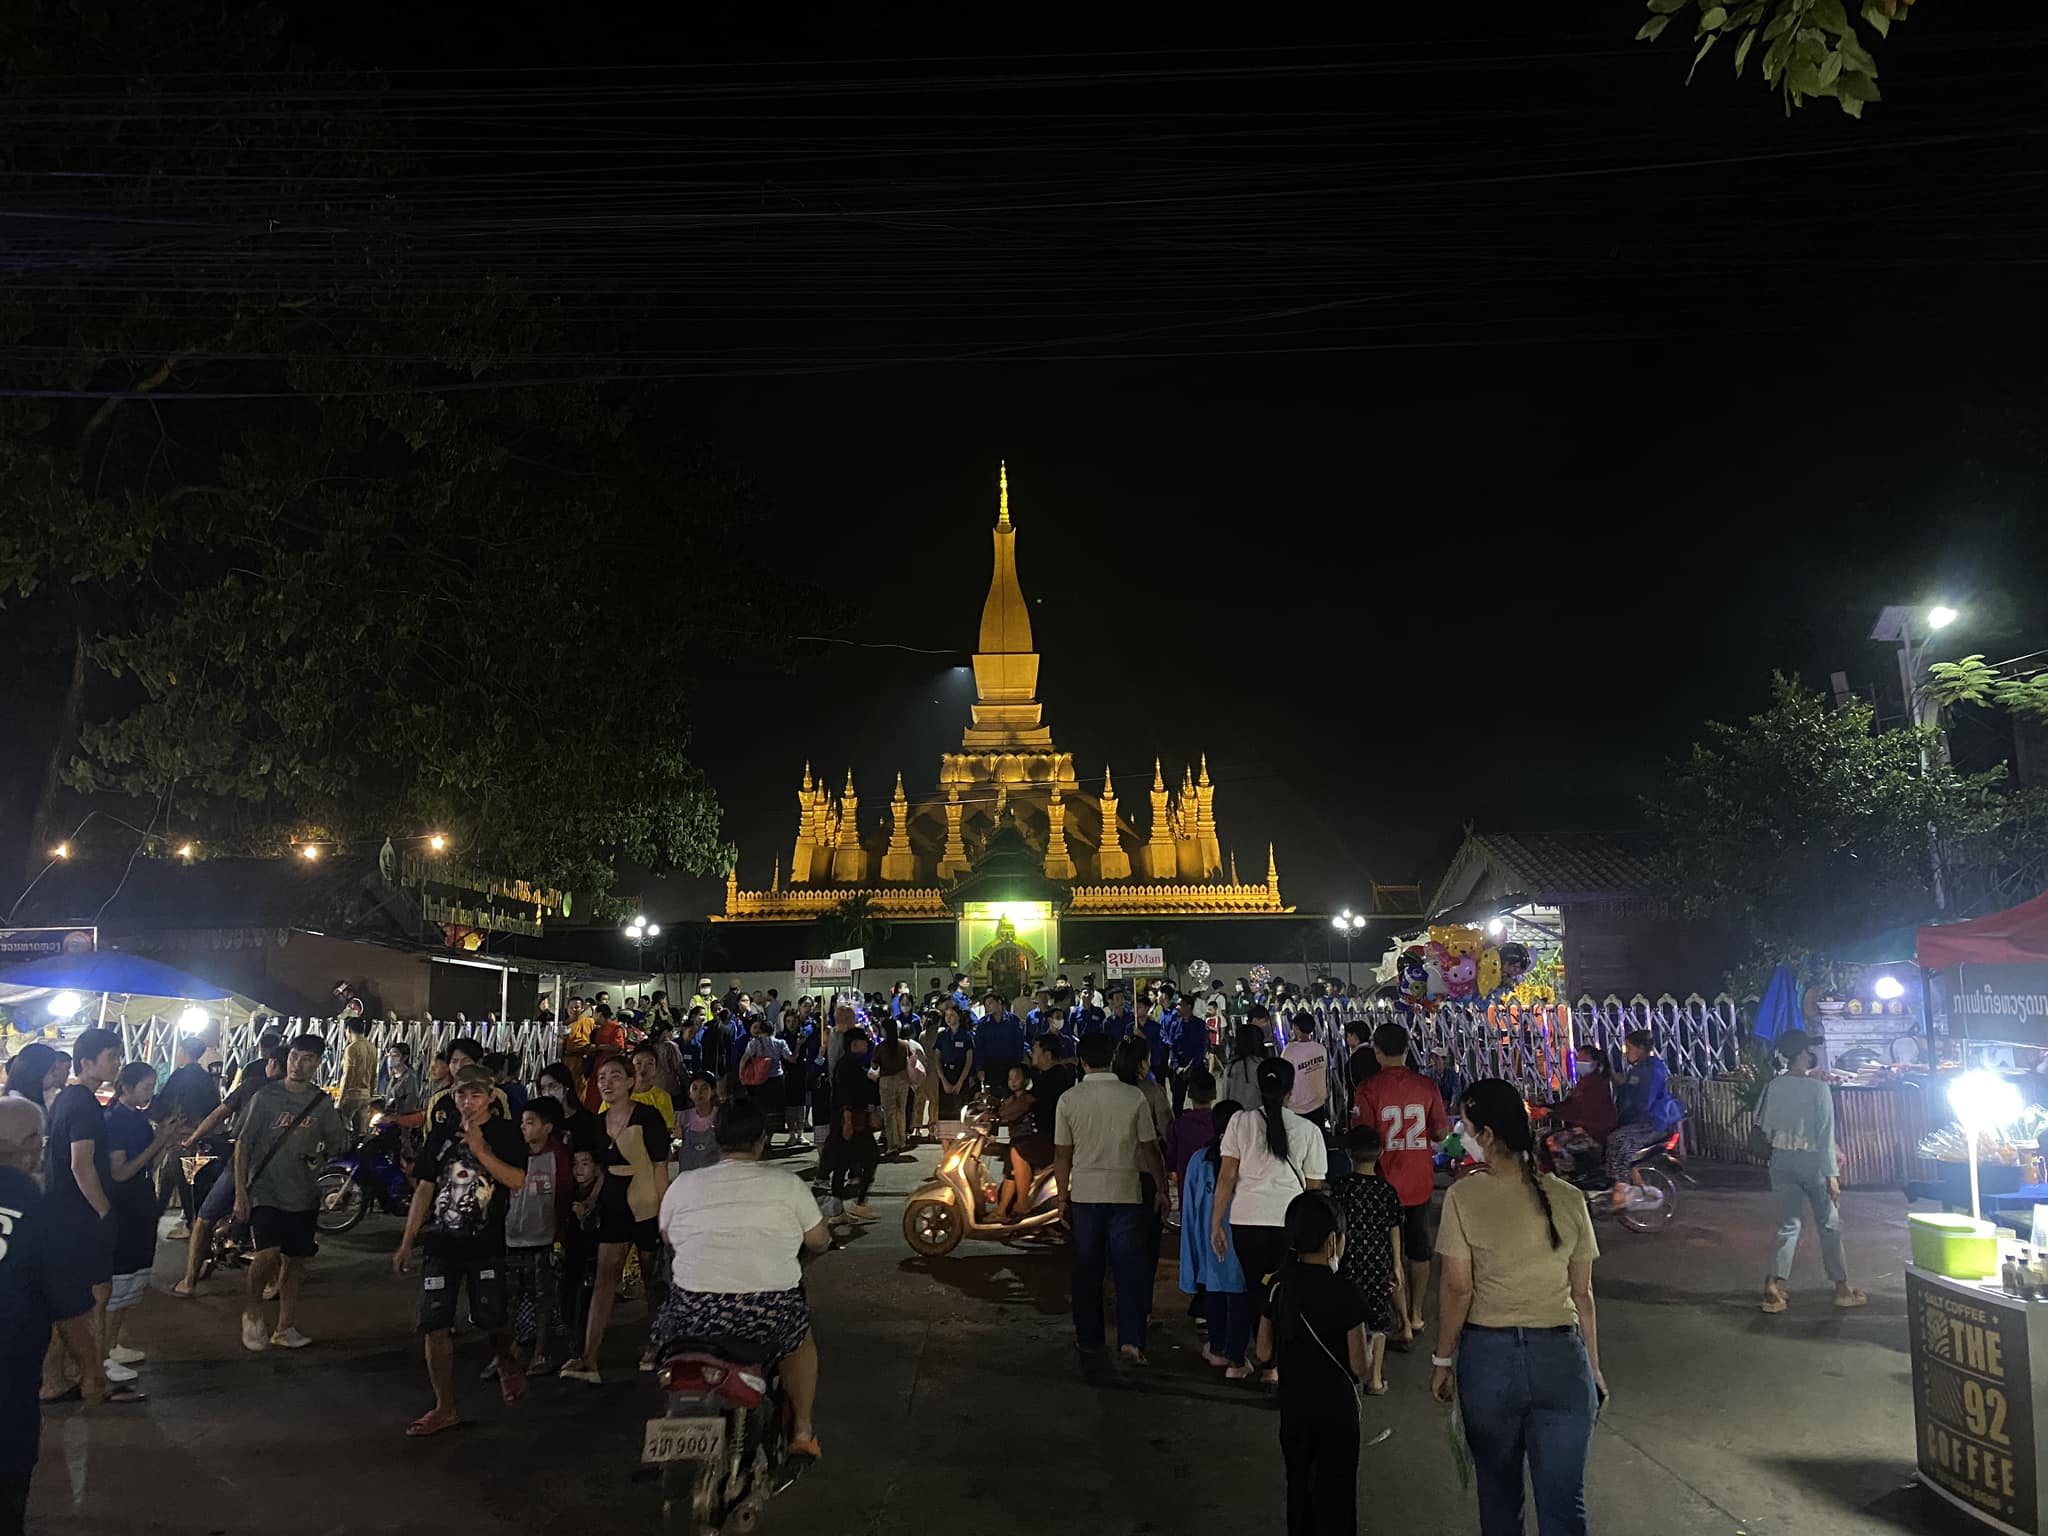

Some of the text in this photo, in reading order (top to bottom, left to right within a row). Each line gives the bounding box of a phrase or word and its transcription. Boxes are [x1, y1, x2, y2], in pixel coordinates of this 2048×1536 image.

[1381, 1104, 1427, 1151] 22
[1945, 1302, 1987, 1325] COFFEE
[1949, 1317, 2005, 1378] THE
[1962, 1380, 2011, 1446] 92
[1926, 1424, 2016, 1498] COFFEE
